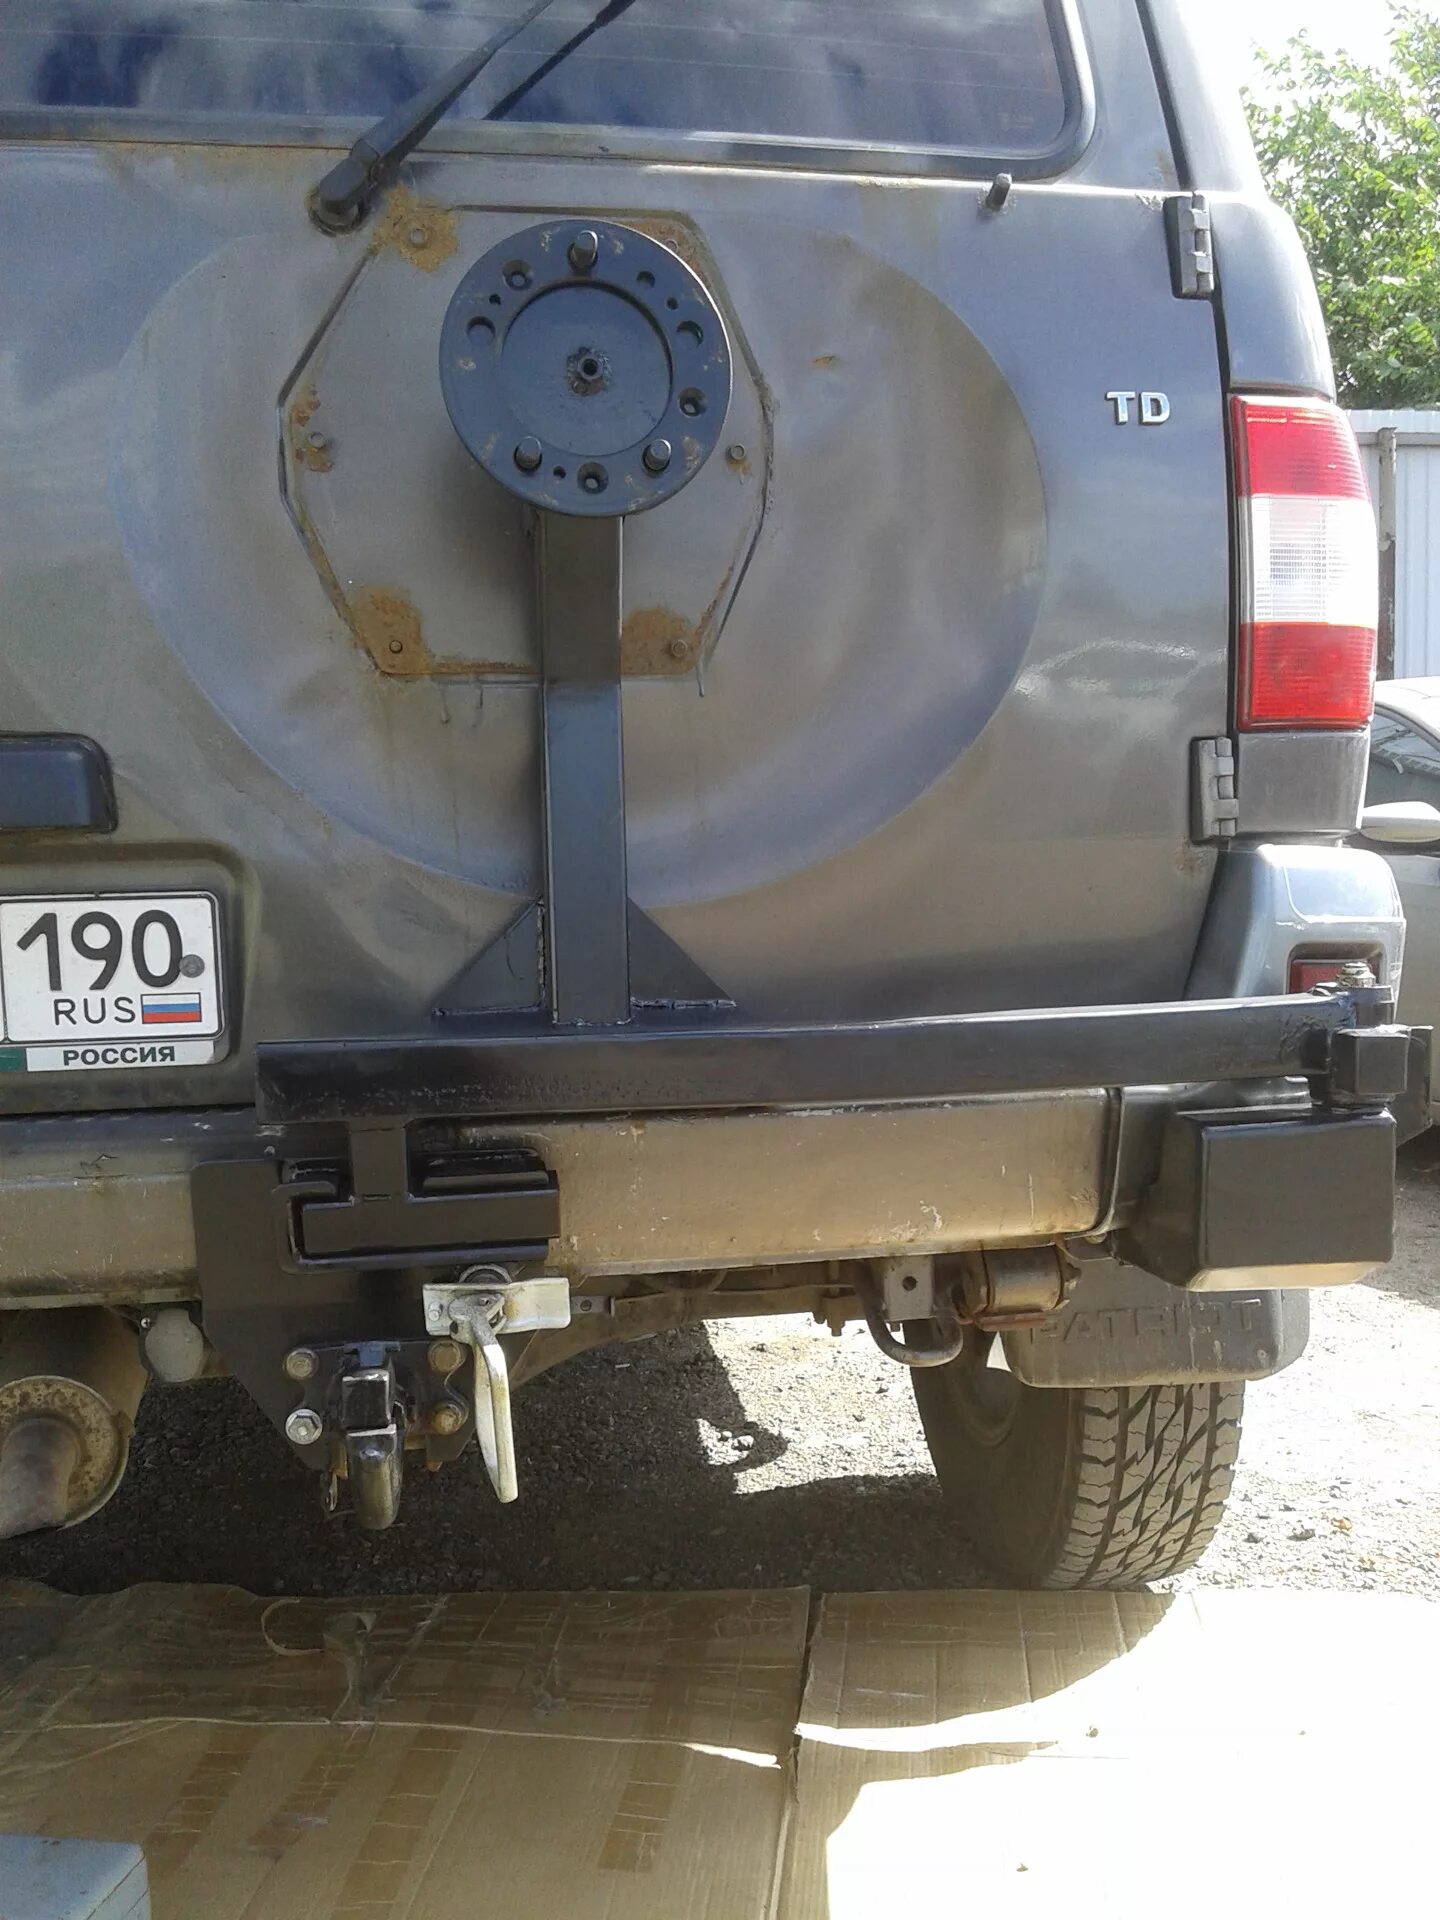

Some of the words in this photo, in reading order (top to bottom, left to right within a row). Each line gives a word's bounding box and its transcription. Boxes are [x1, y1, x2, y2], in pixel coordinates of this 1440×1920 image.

[1105, 391, 1170, 425] TD
[17, 909, 183, 991] 190
[53, 996, 136, 1026] RUS
[63, 1045, 176, 1066] РОССИЯ
